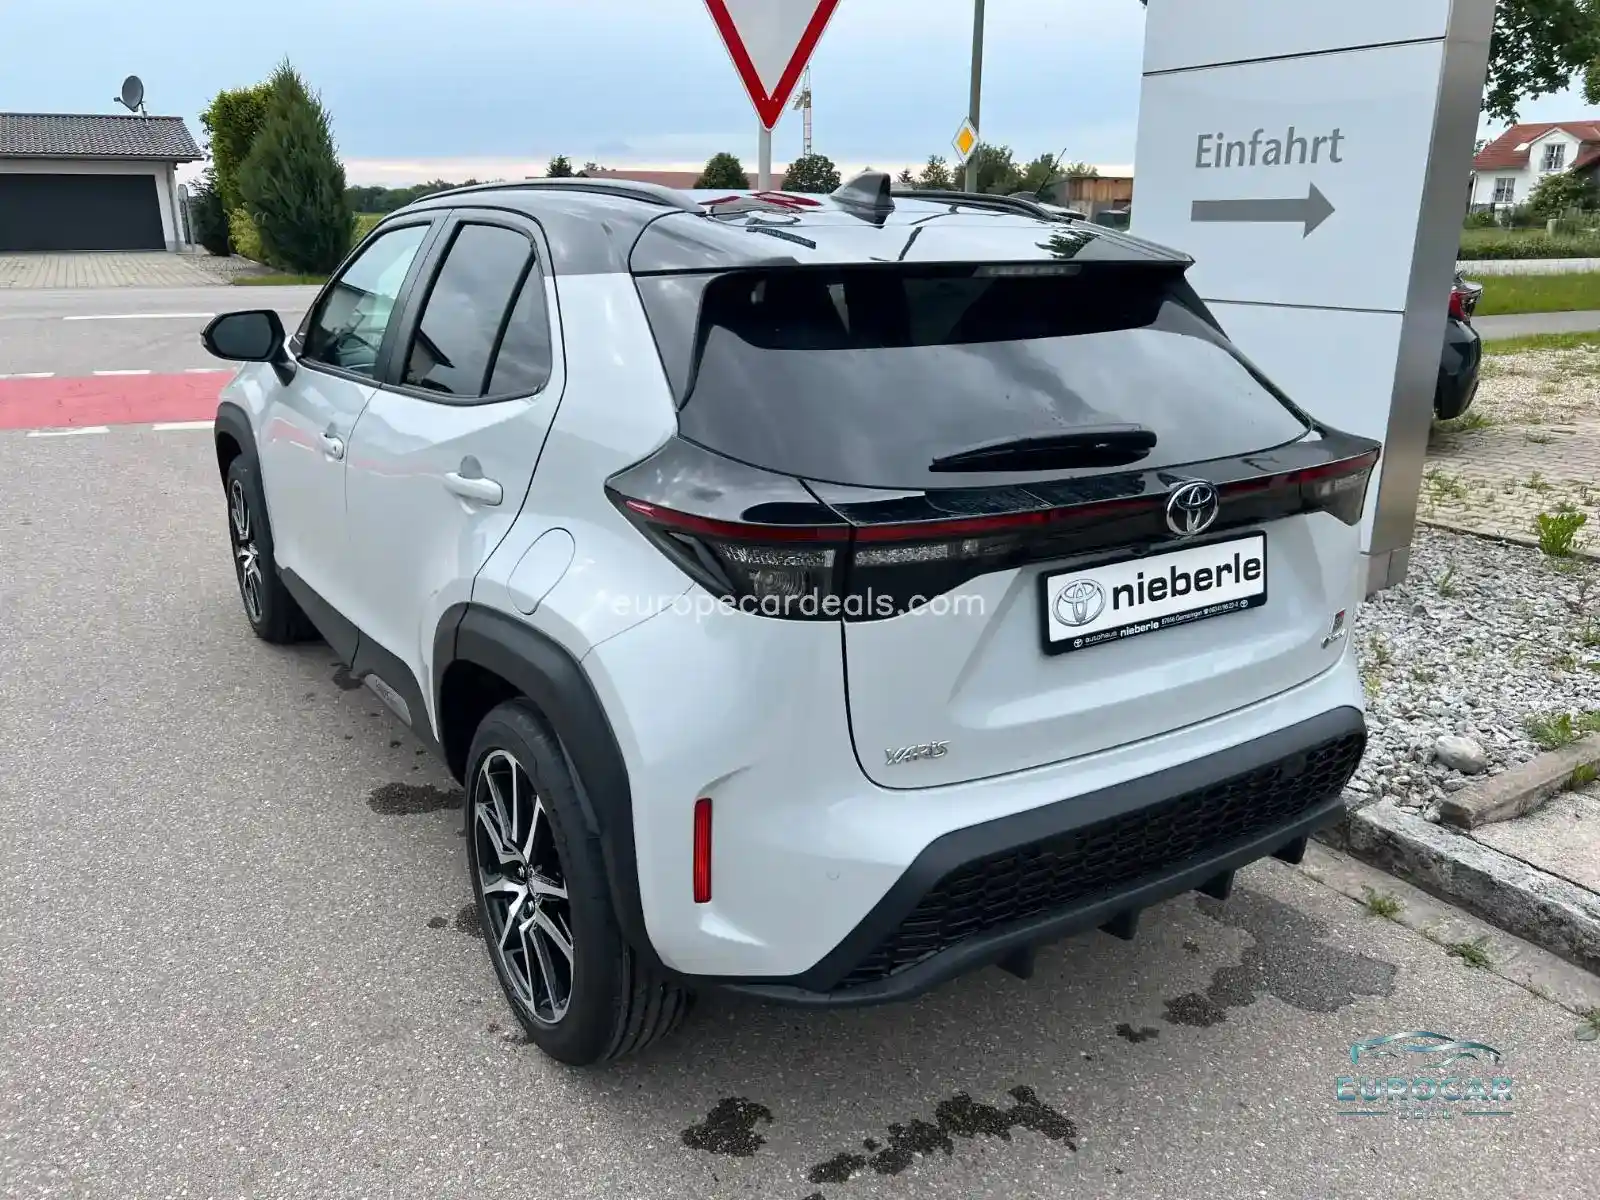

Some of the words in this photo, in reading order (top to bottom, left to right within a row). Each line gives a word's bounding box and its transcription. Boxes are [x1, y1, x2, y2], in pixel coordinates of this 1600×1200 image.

[1195, 126, 1345, 168] Einfahrt
[1112, 552, 1261, 611] nieberle
[1120, 621, 1159, 637] nieberle
[884, 740, 951, 766] YARIS
